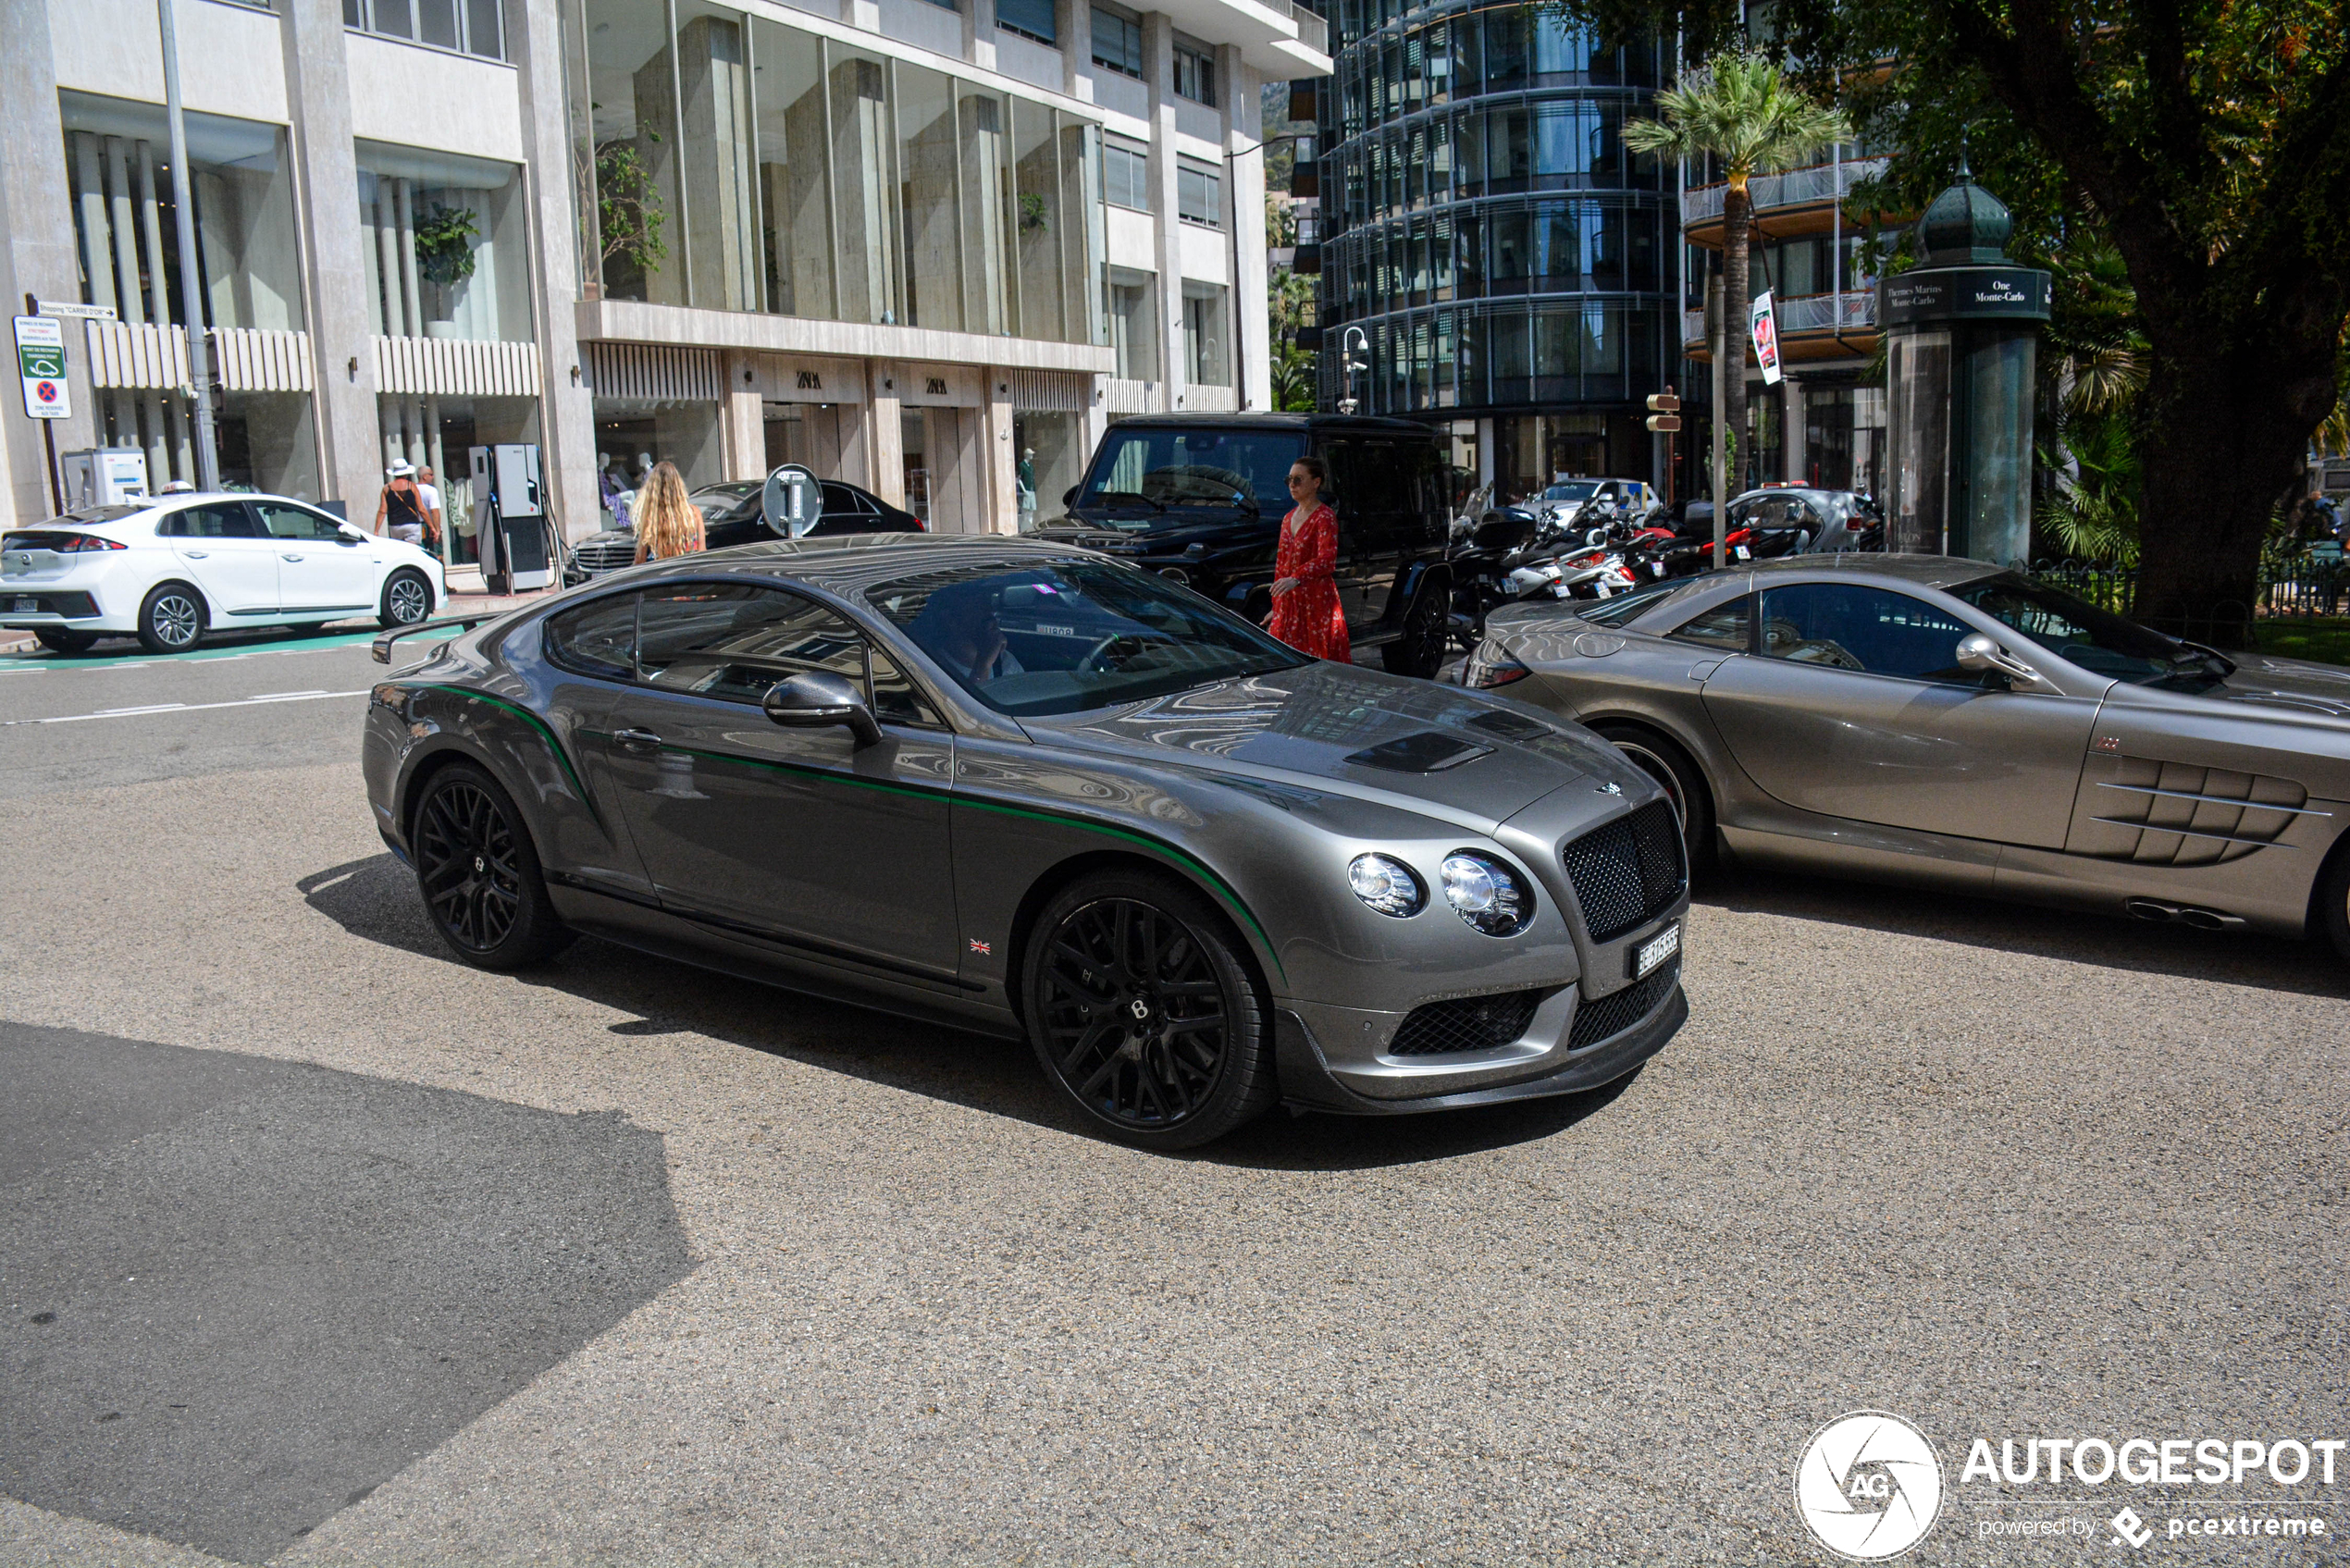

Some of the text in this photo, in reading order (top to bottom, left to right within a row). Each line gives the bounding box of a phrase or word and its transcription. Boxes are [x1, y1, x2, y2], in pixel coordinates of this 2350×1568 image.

[1887, 285, 1942, 298] Thermes Marins
[1992, 280, 2010, 290] One
[1891, 295, 1936, 308] Monte-Carlo
[1975, 291, 2025, 302] Monte-Carlo
[40, 304, 65, 314] Shopping
[796, 371, 822, 389] ZARA
[926, 377, 947, 395] ZARA
